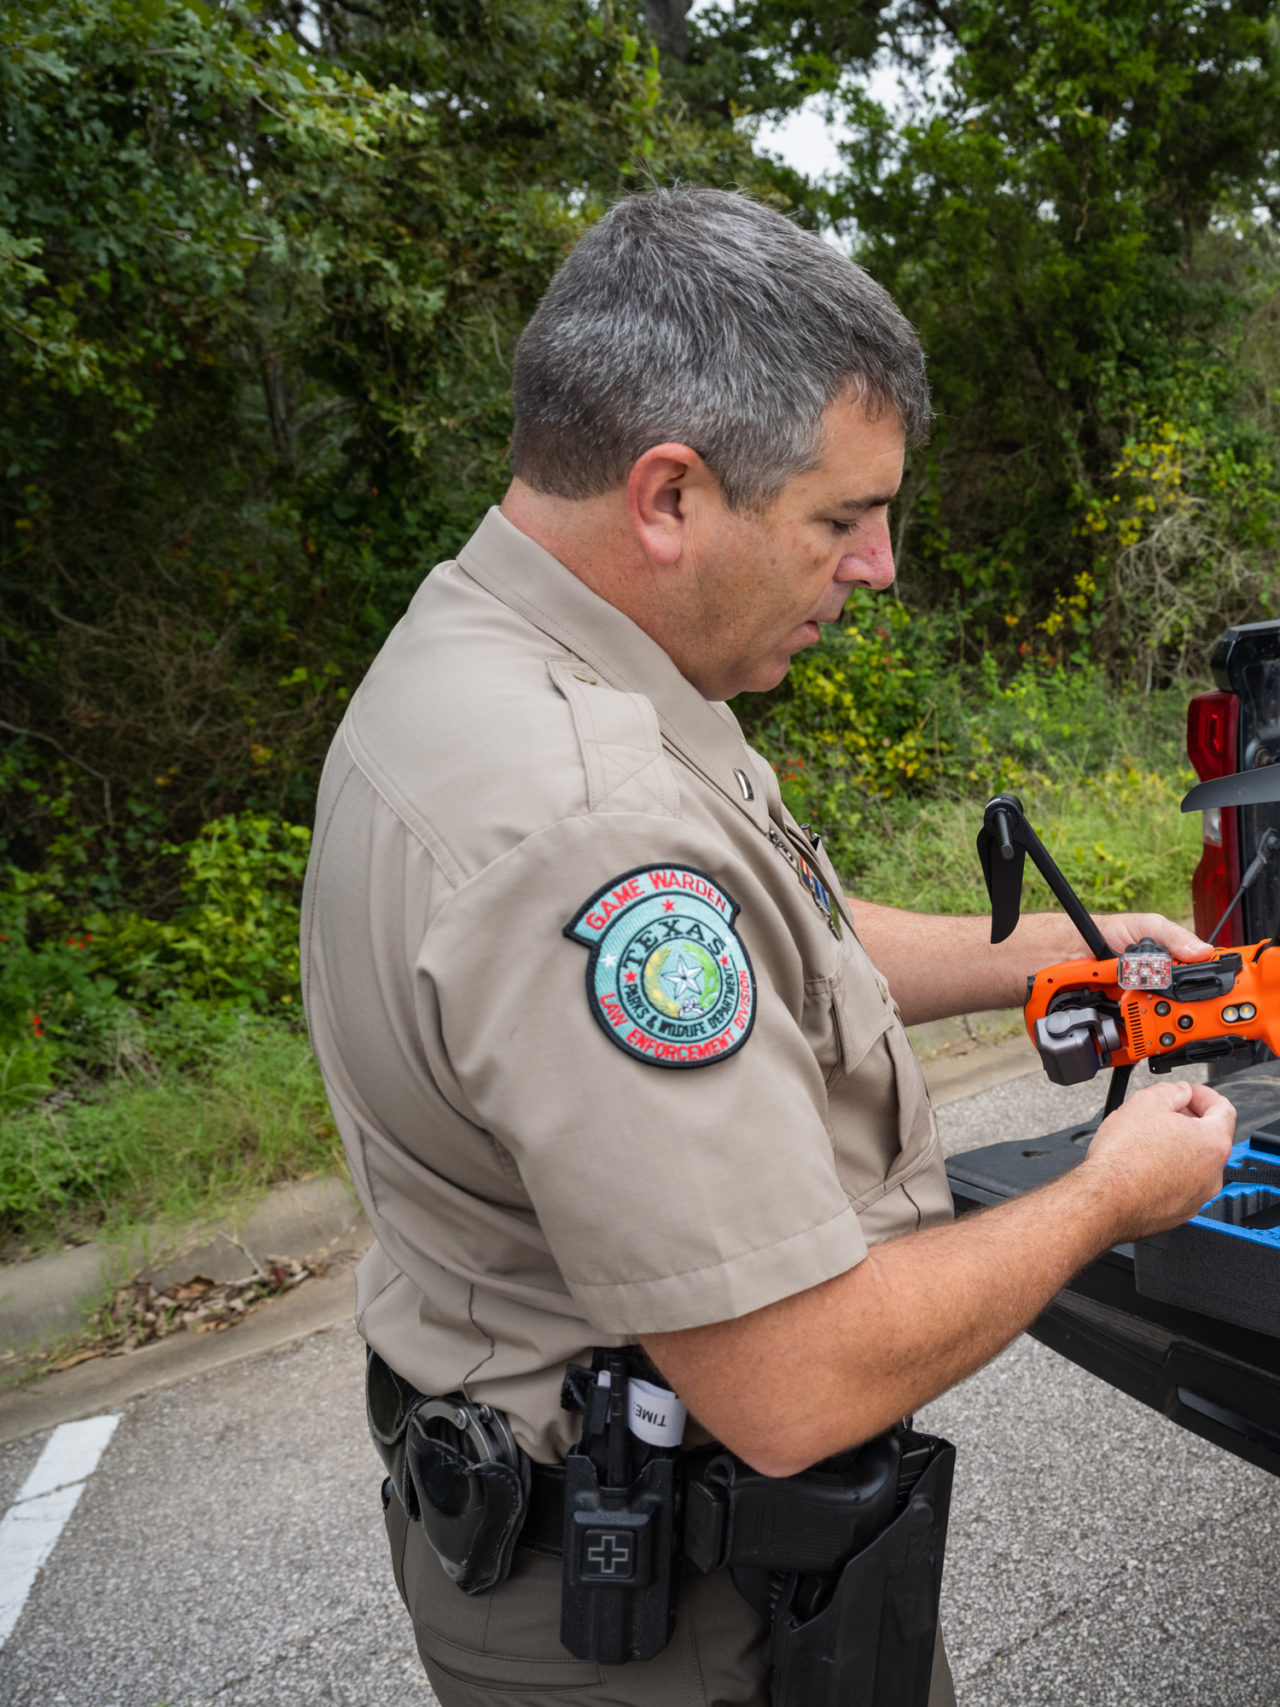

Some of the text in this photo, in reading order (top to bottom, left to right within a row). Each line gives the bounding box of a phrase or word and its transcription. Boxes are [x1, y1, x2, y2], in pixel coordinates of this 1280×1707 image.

[585, 870, 726, 931] GAME WARDEN
[623, 919, 727, 969] TEXAS
[599, 969, 751, 1062] LAW ENFORCEMENT DIVISION
[623, 966, 736, 1038] PARKS & WILDLIFE DEPARTMENT
